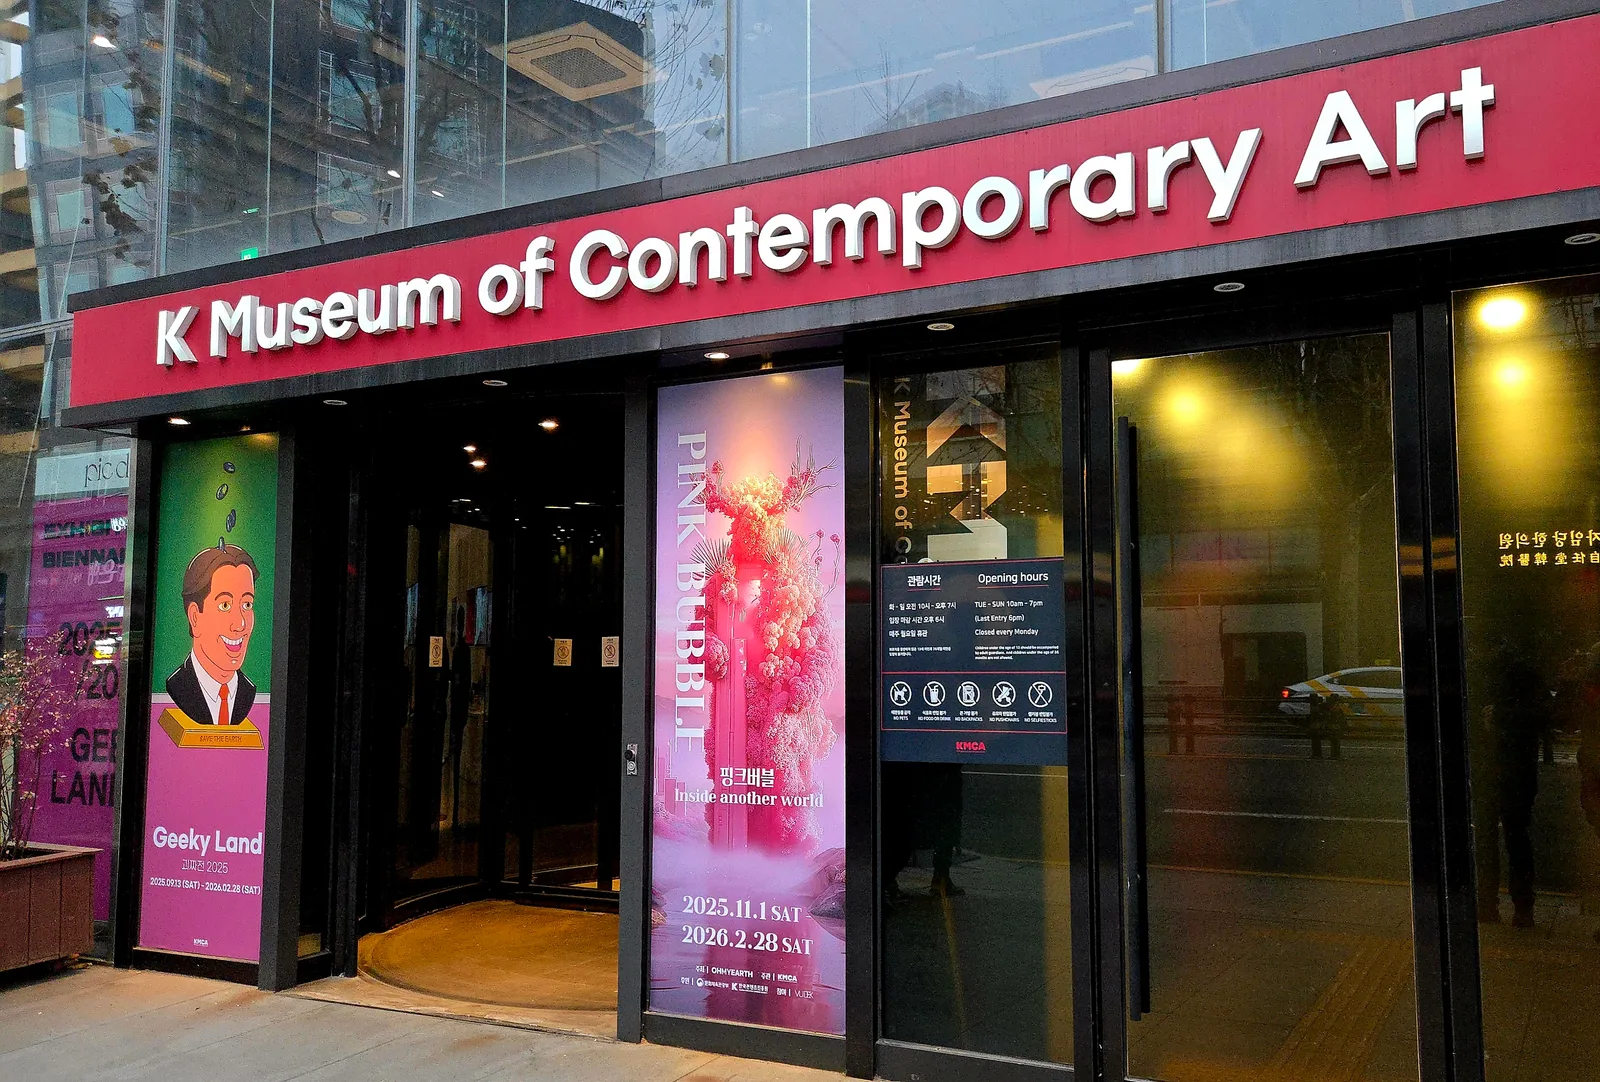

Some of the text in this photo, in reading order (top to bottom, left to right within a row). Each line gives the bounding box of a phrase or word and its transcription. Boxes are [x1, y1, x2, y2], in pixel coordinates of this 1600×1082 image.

[156, 67, 1496, 366] K Museum of Contemporary Art
[894, 377, 911, 394] K
[894, 401, 911, 498] Museum
[894, 505, 912, 530] of
[907, 575, 941, 586] 관람시간
[978, 572, 1049, 585] Opening hours
[674, 430, 707, 753] PINK BUBBLE
[906, 602, 916, 610] 오전
[956, 742, 986, 750] KMCA
[719, 767, 775, 788] 핑크버블
[675, 788, 823, 808] Inside another world
[152, 826, 262, 856] Geeky Land
[207, 861, 229, 874] 2025
[150, 877, 182, 888] 2025.09.13
[182, 880, 200, 890] (SAT)
[205, 882, 240, 893] 2026.02.28
[241, 885, 261, 895] (SAT)
[682, 895, 767, 921] 2025.11.1
[771, 905, 802, 923] SAT
[681, 925, 814, 955] 2026.2.28 SAT
[711, 966, 753, 978] OHMYEARTH
[778, 973, 798, 982] KMCA
